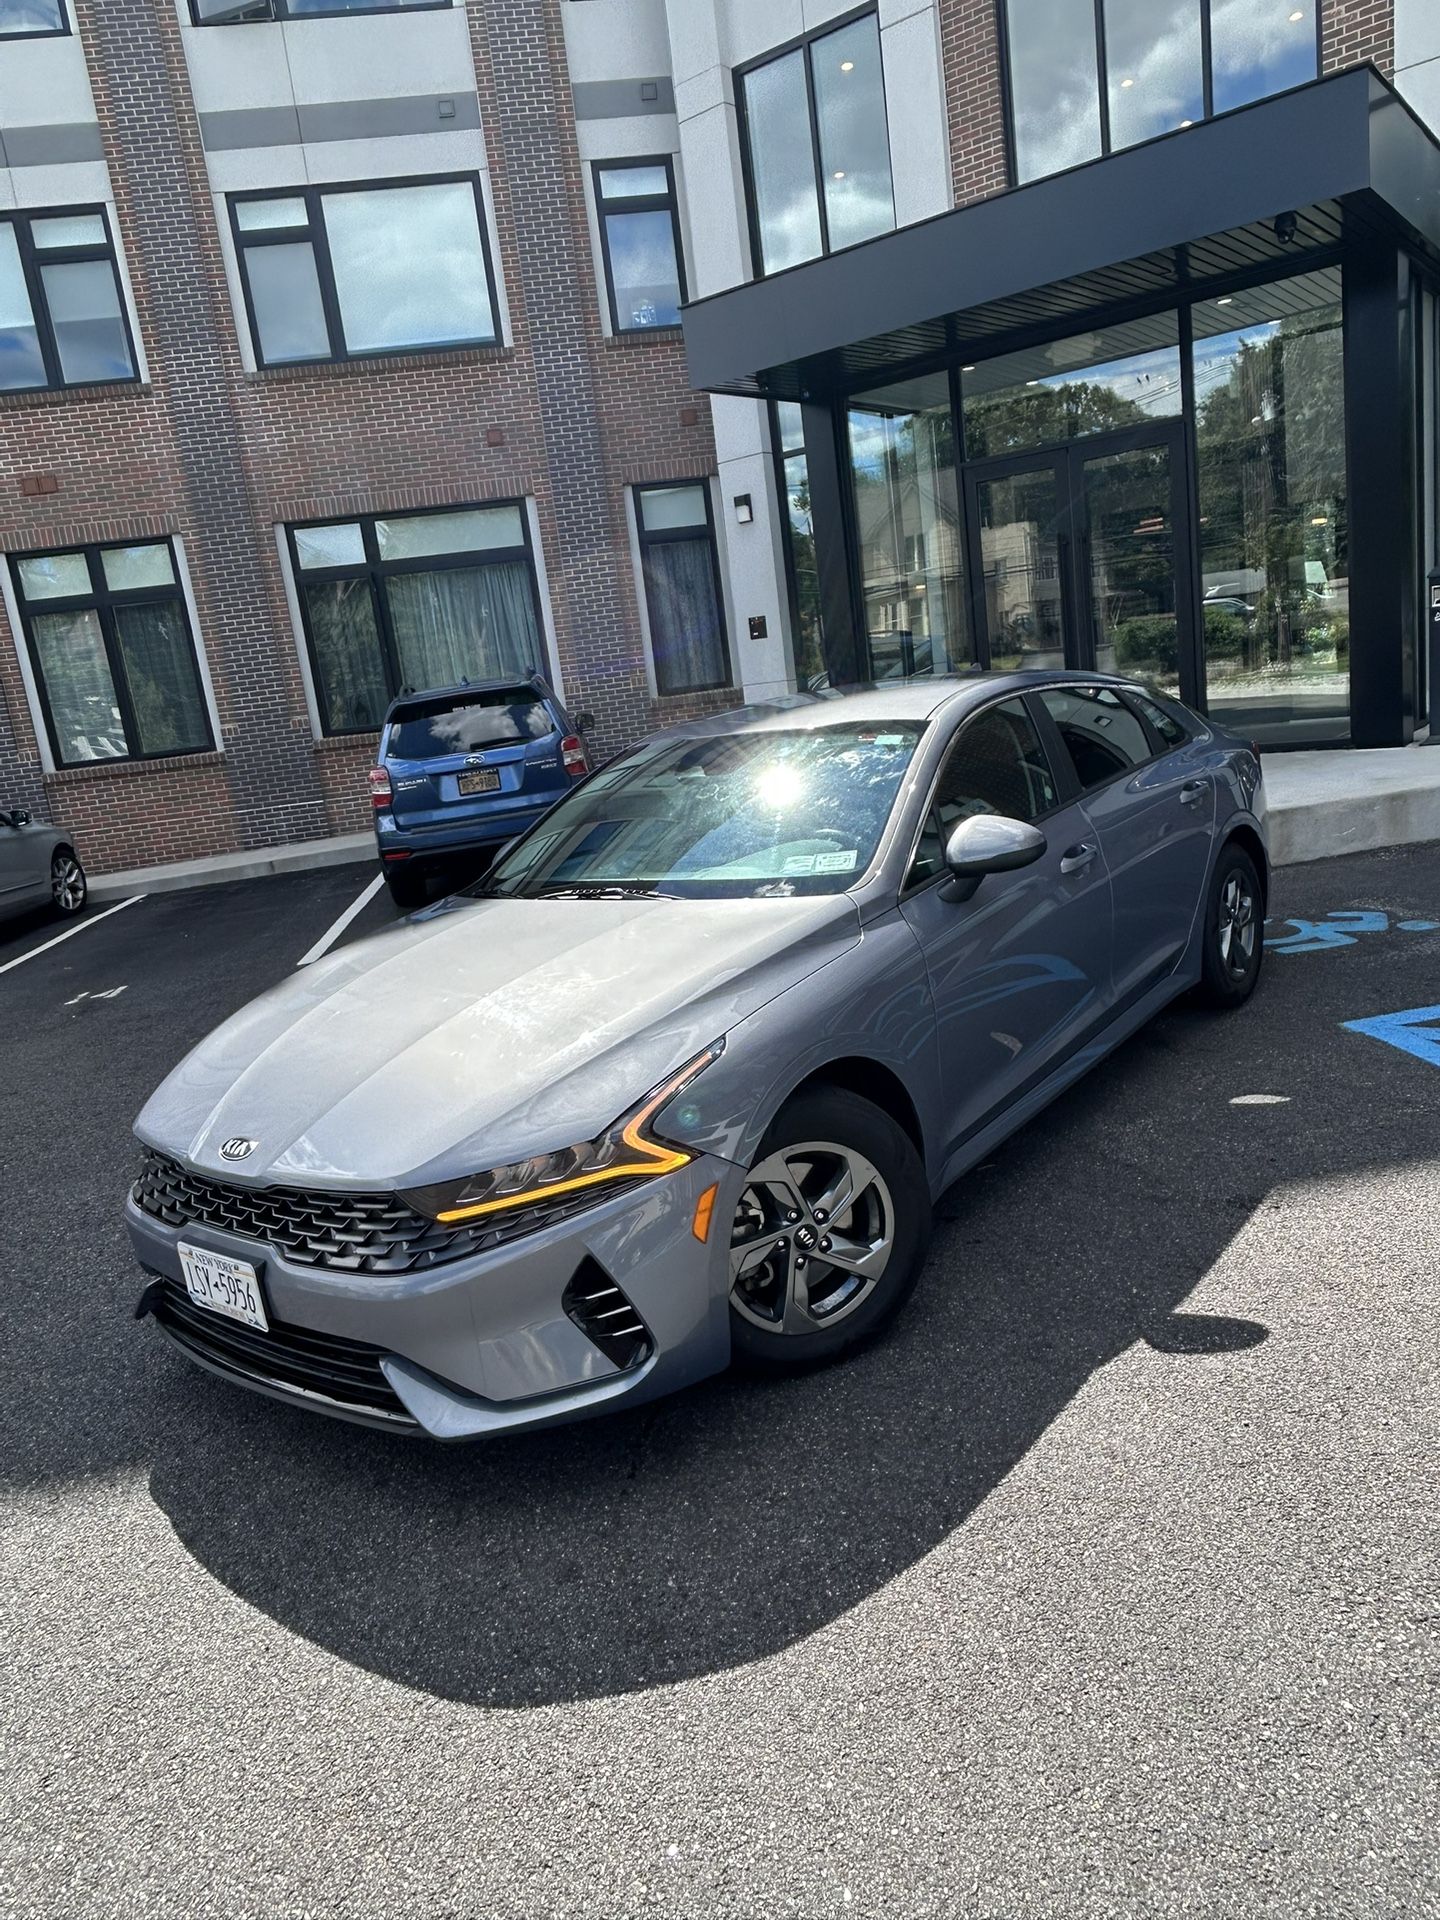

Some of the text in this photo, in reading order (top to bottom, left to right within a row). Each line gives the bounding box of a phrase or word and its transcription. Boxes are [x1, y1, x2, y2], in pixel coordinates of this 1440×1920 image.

[221, 1138, 250, 1157] KIA
[798, 1227, 815, 1248] KIA
[194, 1252, 234, 1273] NEW YORK
